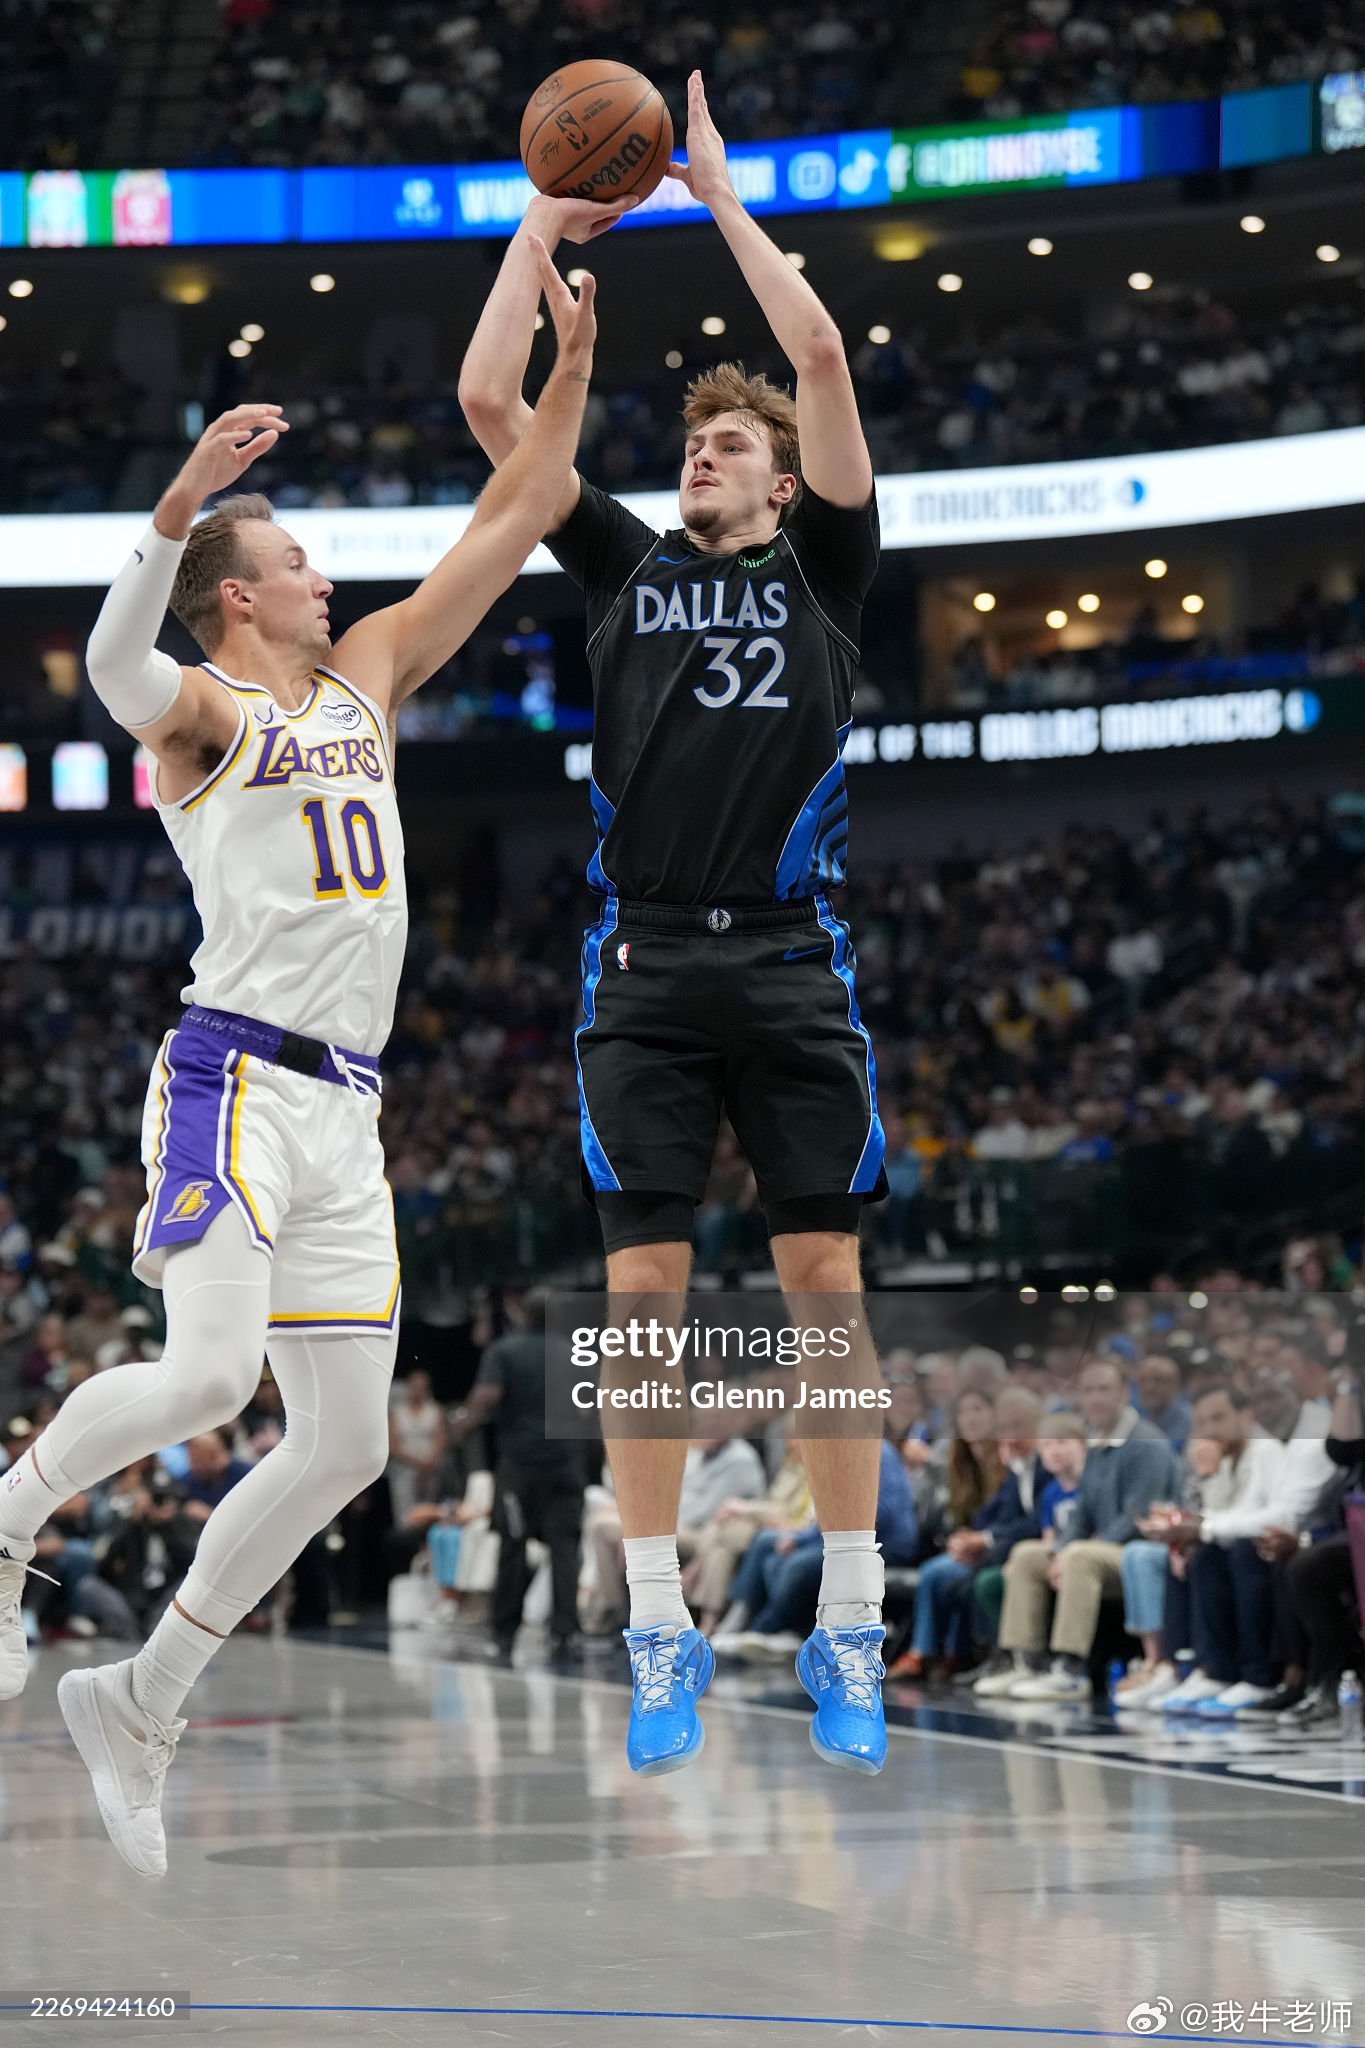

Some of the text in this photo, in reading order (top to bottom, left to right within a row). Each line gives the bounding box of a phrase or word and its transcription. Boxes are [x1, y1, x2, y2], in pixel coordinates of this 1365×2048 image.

[633, 577, 788, 636] DALLAS
[691, 635, 789, 708] 32
[241, 724, 384, 790] LAKERS
[301, 797, 390, 899] 10
